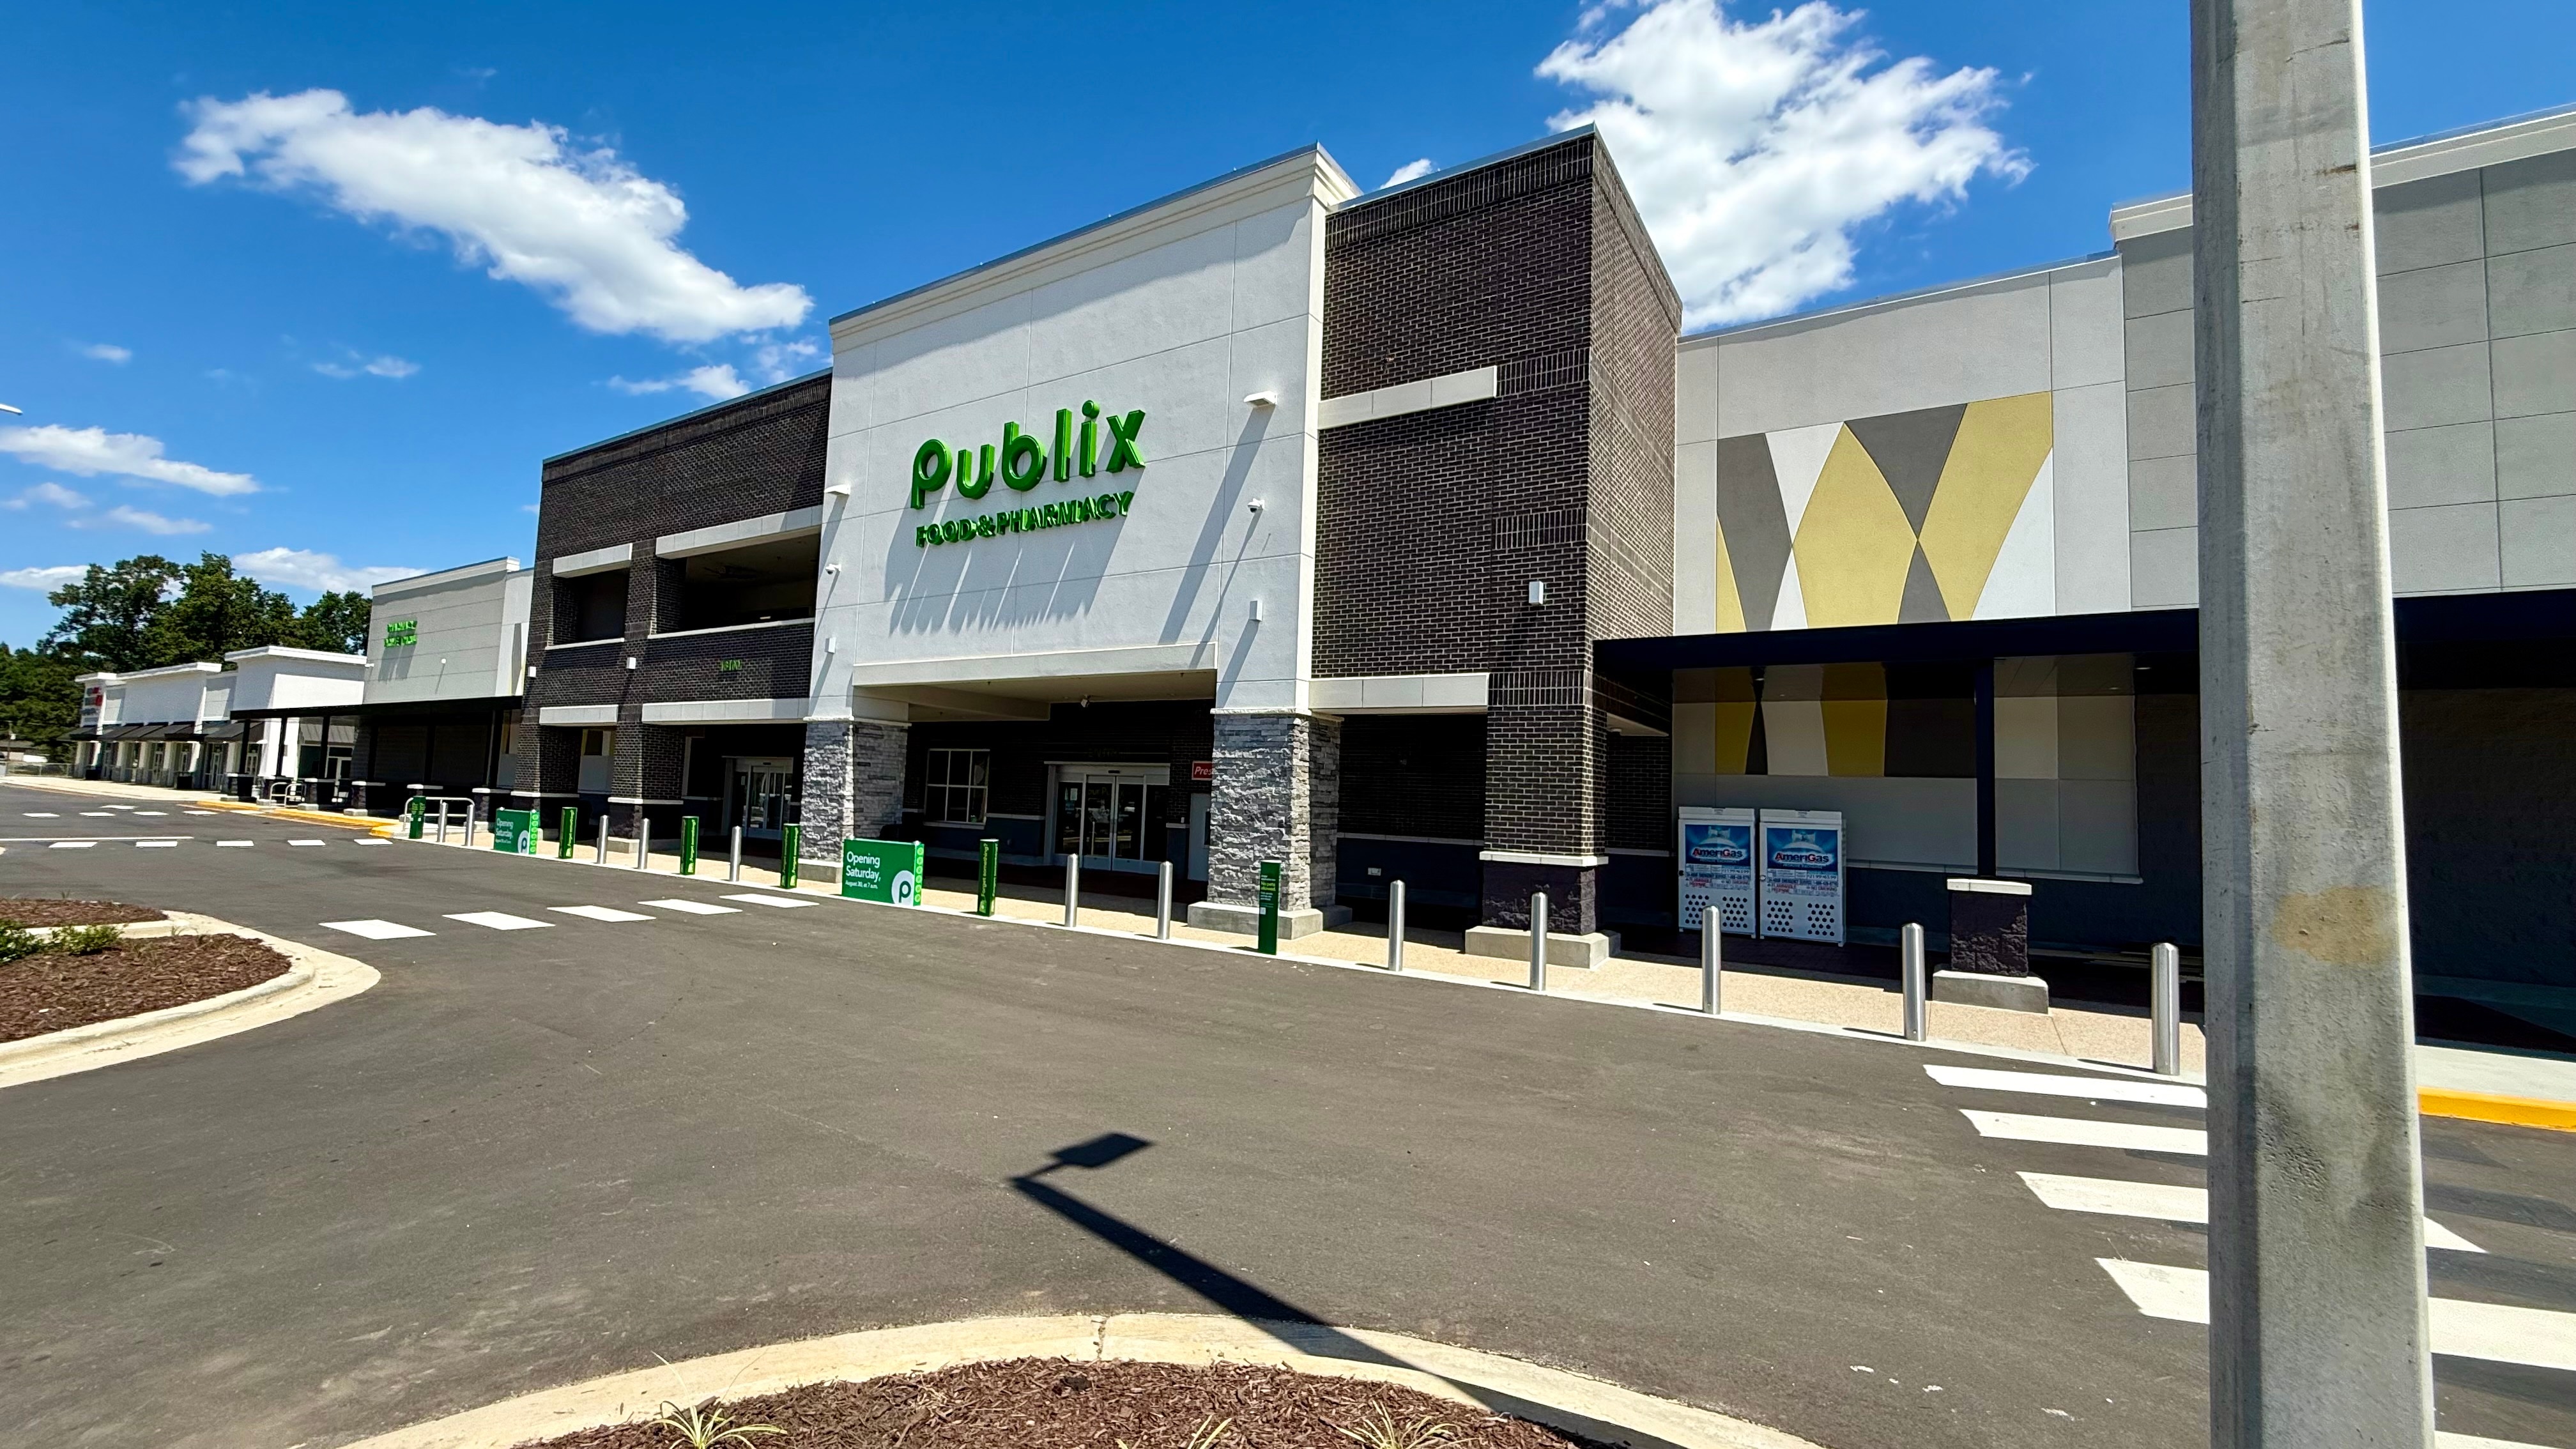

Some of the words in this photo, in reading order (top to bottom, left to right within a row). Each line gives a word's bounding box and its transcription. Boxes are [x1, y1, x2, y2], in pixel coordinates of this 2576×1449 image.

[910, 400, 1146, 509] Publix
[915, 518, 977, 548] FOOD
[996, 491, 1135, 535] PHARMACY
[847, 851, 880, 868] Opening
[1692, 848, 1744, 857] AmeriGas
[1775, 852, 1829, 862] AmeriGas
[846, 865, 881, 882] Saturday,
